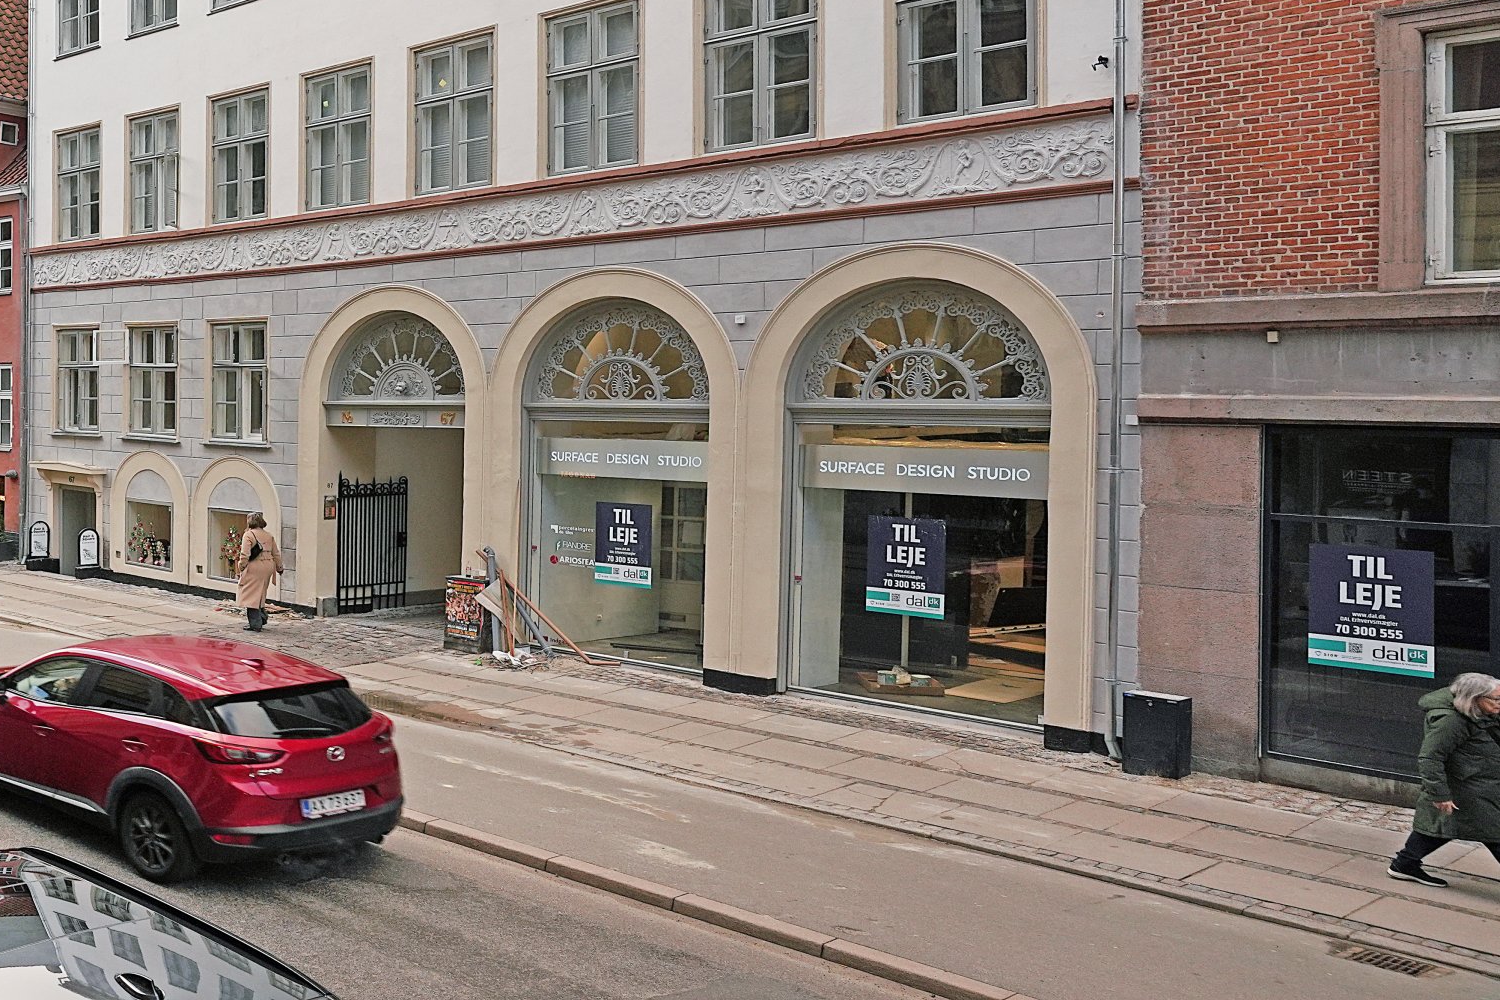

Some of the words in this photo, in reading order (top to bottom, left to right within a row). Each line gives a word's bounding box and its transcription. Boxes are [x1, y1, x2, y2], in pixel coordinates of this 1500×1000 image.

[551, 451, 599, 463] SURFACE
[606, 453, 649, 465] DESIGN
[658, 455, 702, 467] STUDIO
[819, 460, 885, 474] SURFACE
[896, 463, 955, 478] DESIGN
[967, 466, 1031, 482] STUDIO
[613, 508, 635, 525] TIL
[609, 527, 638, 545] LEJE
[892, 523, 921, 543] TIL
[560, 556, 594, 566] ARIOSTEA
[886, 545, 926, 568] LEJE
[623, 568, 638, 579] dal
[1347, 554, 1393, 580] TIL
[883, 578, 893, 587] 70
[894, 579, 909, 588] 300
[910, 581, 926, 590] 555
[906, 594, 926, 607] dal
[1339, 581, 1402, 611] LEJE
[1352, 611, 1386, 620] www.dal.dk
[1352, 617, 1398, 627] Erhvervsmægler
[1335, 623, 1350, 634] 70
[1353, 625, 1376, 637] 300
[1379, 628, 1403, 640] 555
[1372, 645, 1405, 661] dal
[1409, 650, 1425, 660] dk
